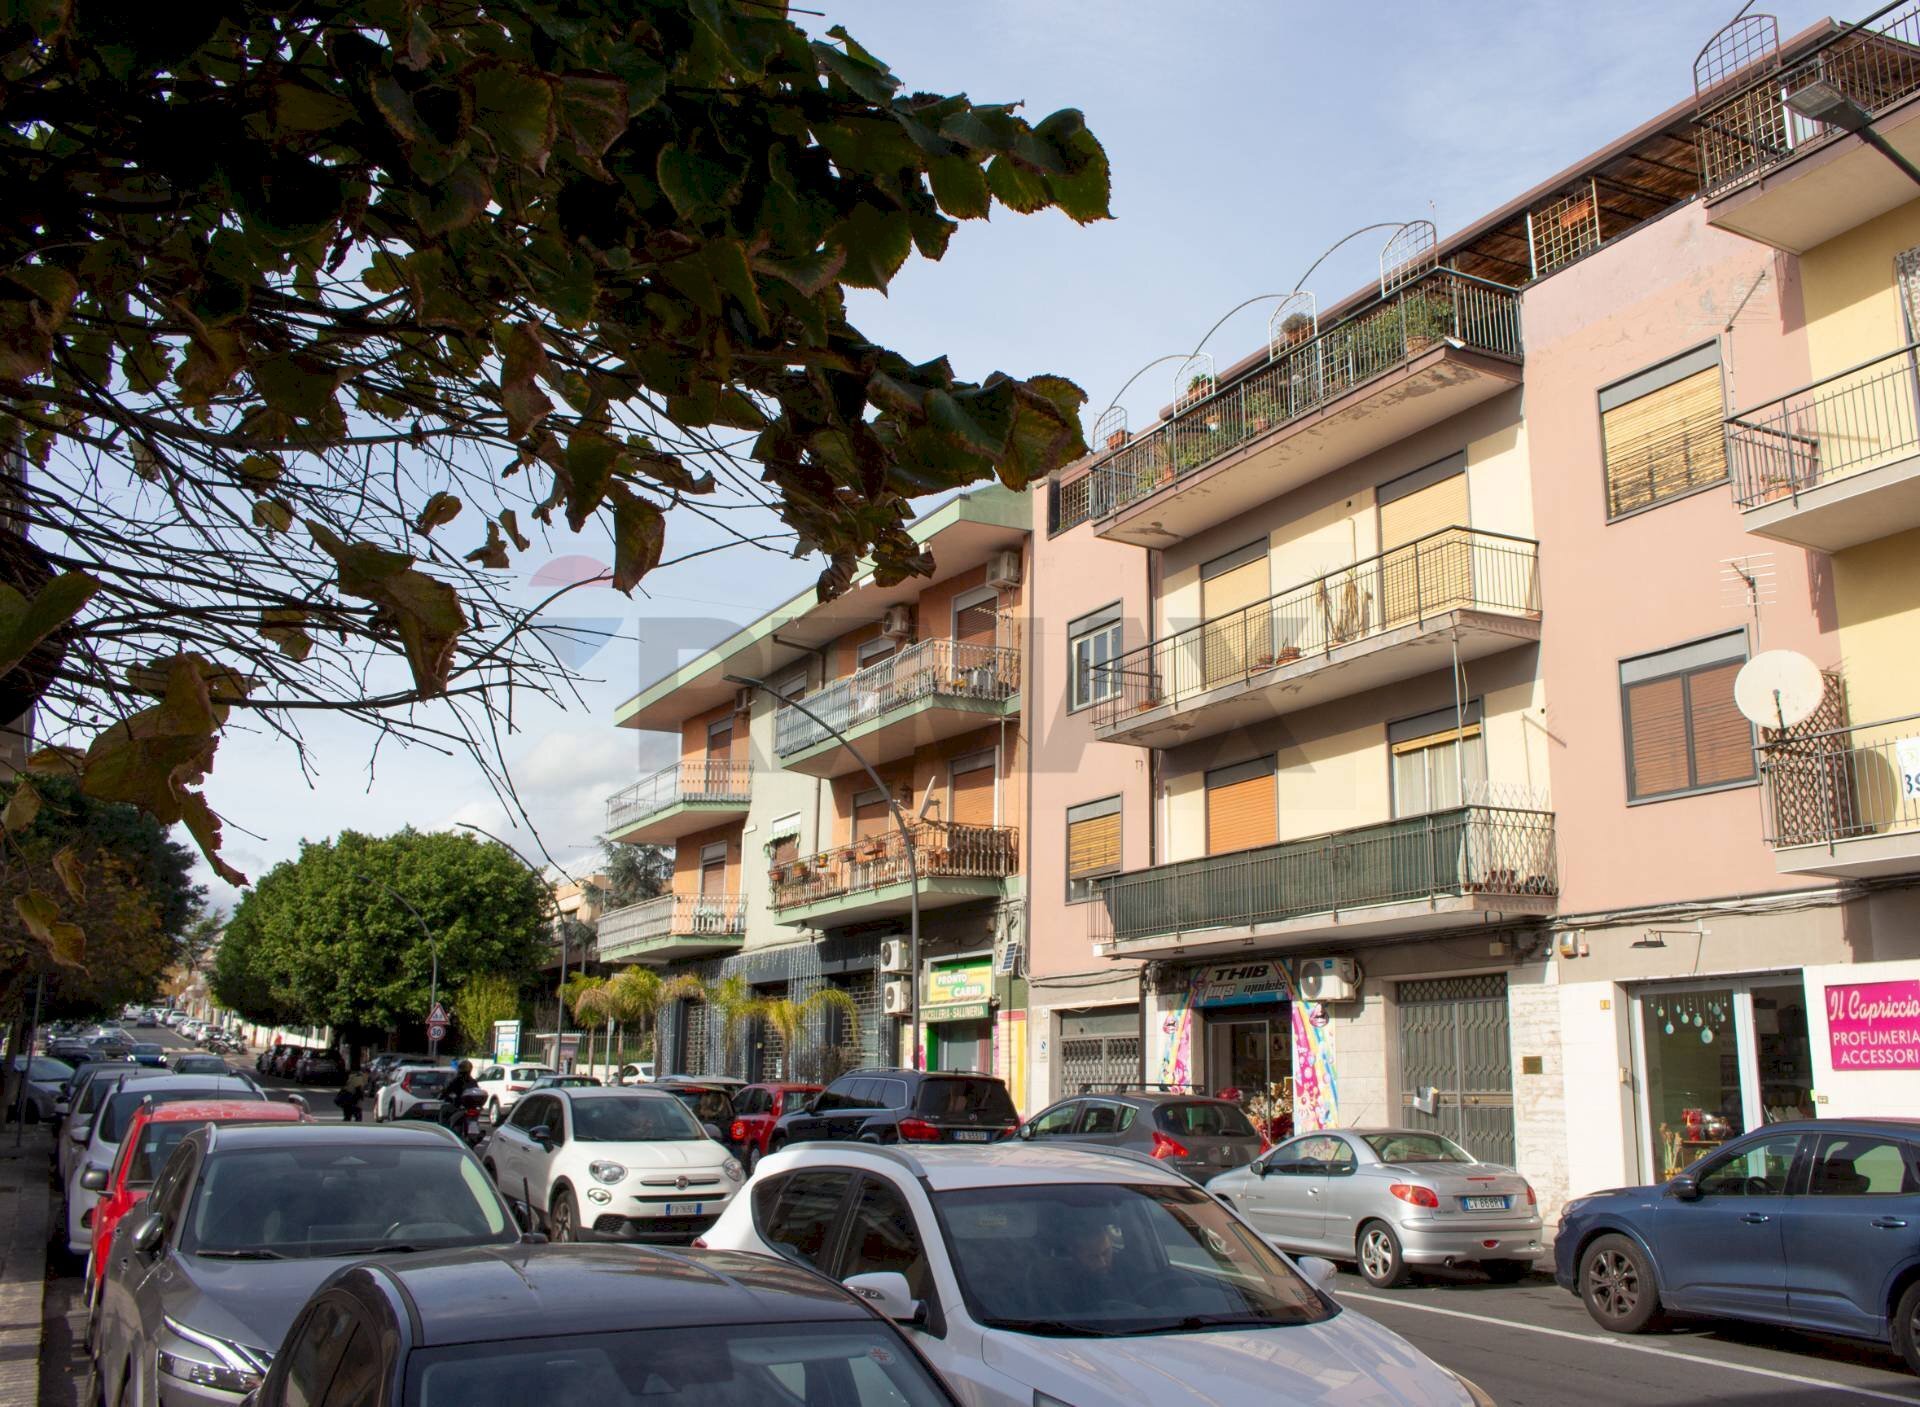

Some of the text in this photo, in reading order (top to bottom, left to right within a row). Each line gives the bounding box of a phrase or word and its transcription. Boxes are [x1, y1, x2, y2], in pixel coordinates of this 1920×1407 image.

[937, 974, 967, 985] PRONTO
[1215, 965, 1269, 981] THIB
[954, 985, 983, 997] CARNI
[1829, 990, 1920, 1027] Il Capriccio
[1832, 1029, 1920, 1046] PROFUMERIA
[1841, 1048, 1919, 1064] ACCESSORI
